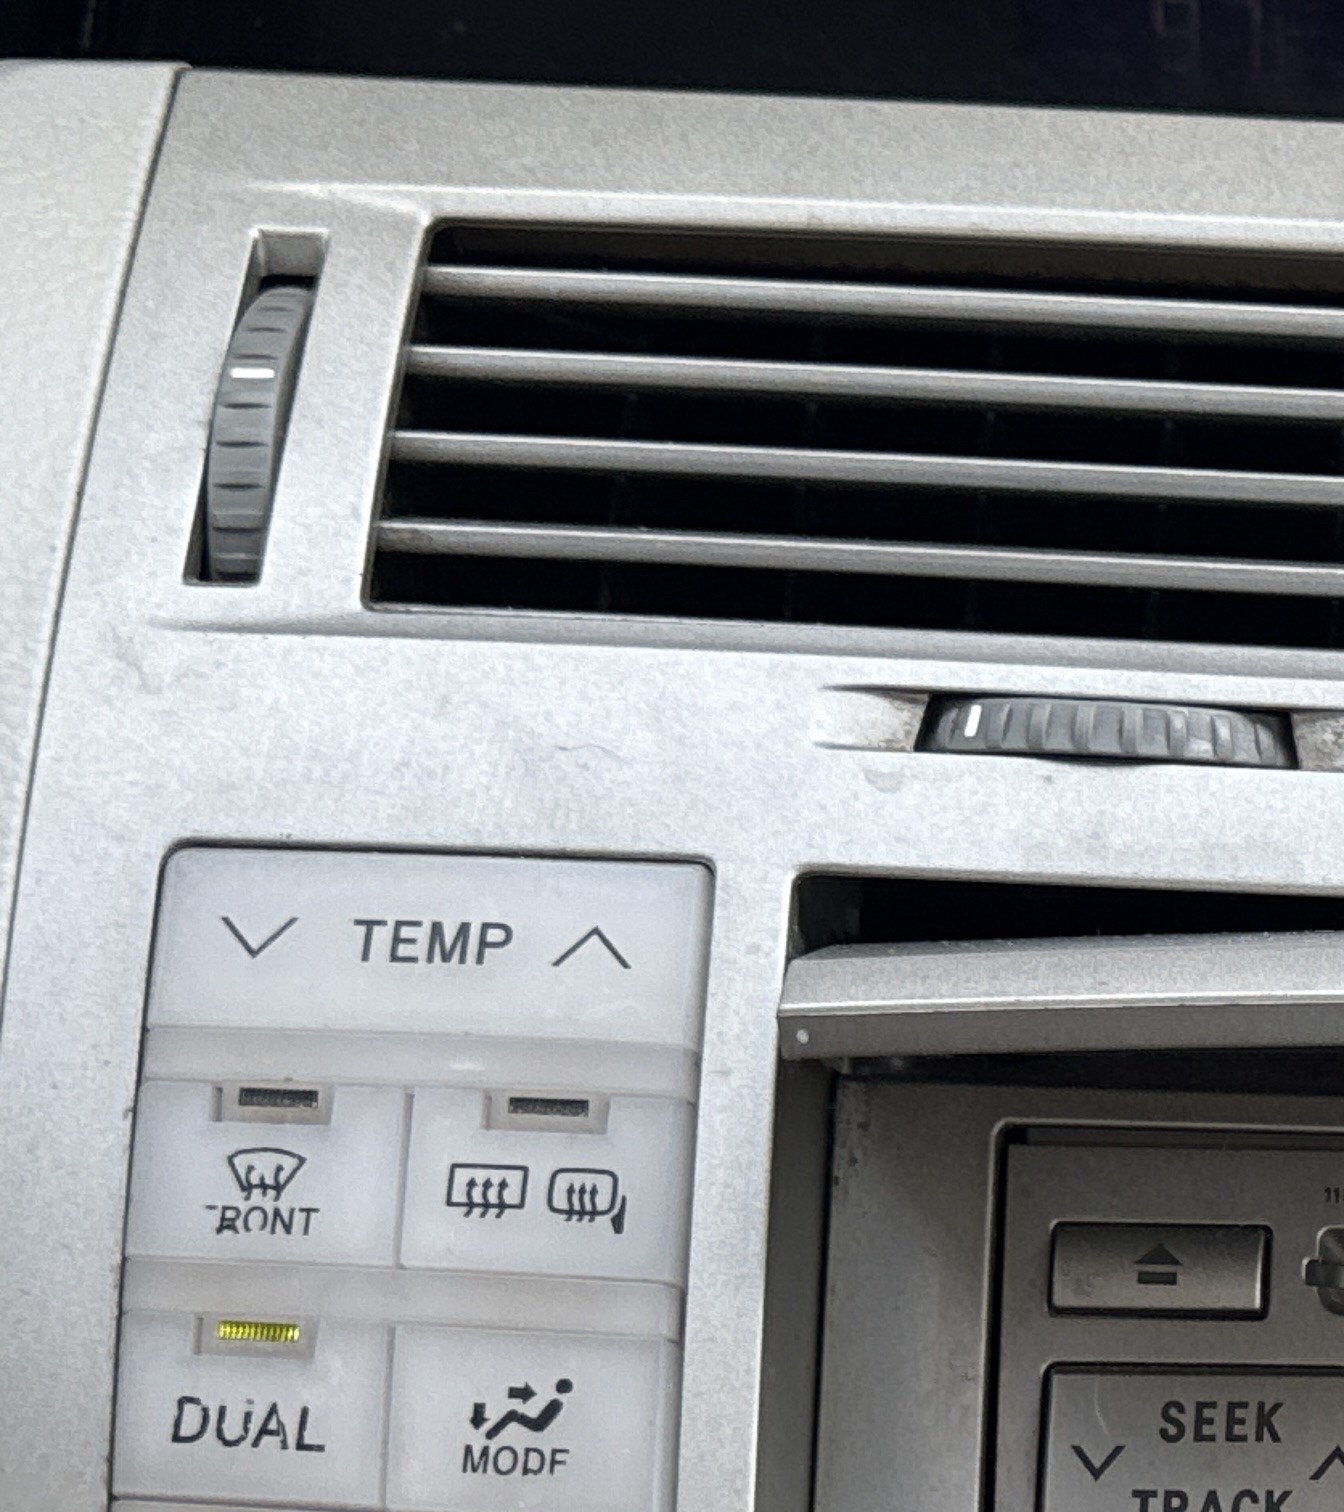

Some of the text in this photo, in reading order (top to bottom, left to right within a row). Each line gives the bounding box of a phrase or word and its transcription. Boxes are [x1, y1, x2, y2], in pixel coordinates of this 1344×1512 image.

[353, 918, 513, 966] TEMP
[170, 1395, 325, 1453] DUAL
[1158, 1400, 1284, 1444] SEEK
